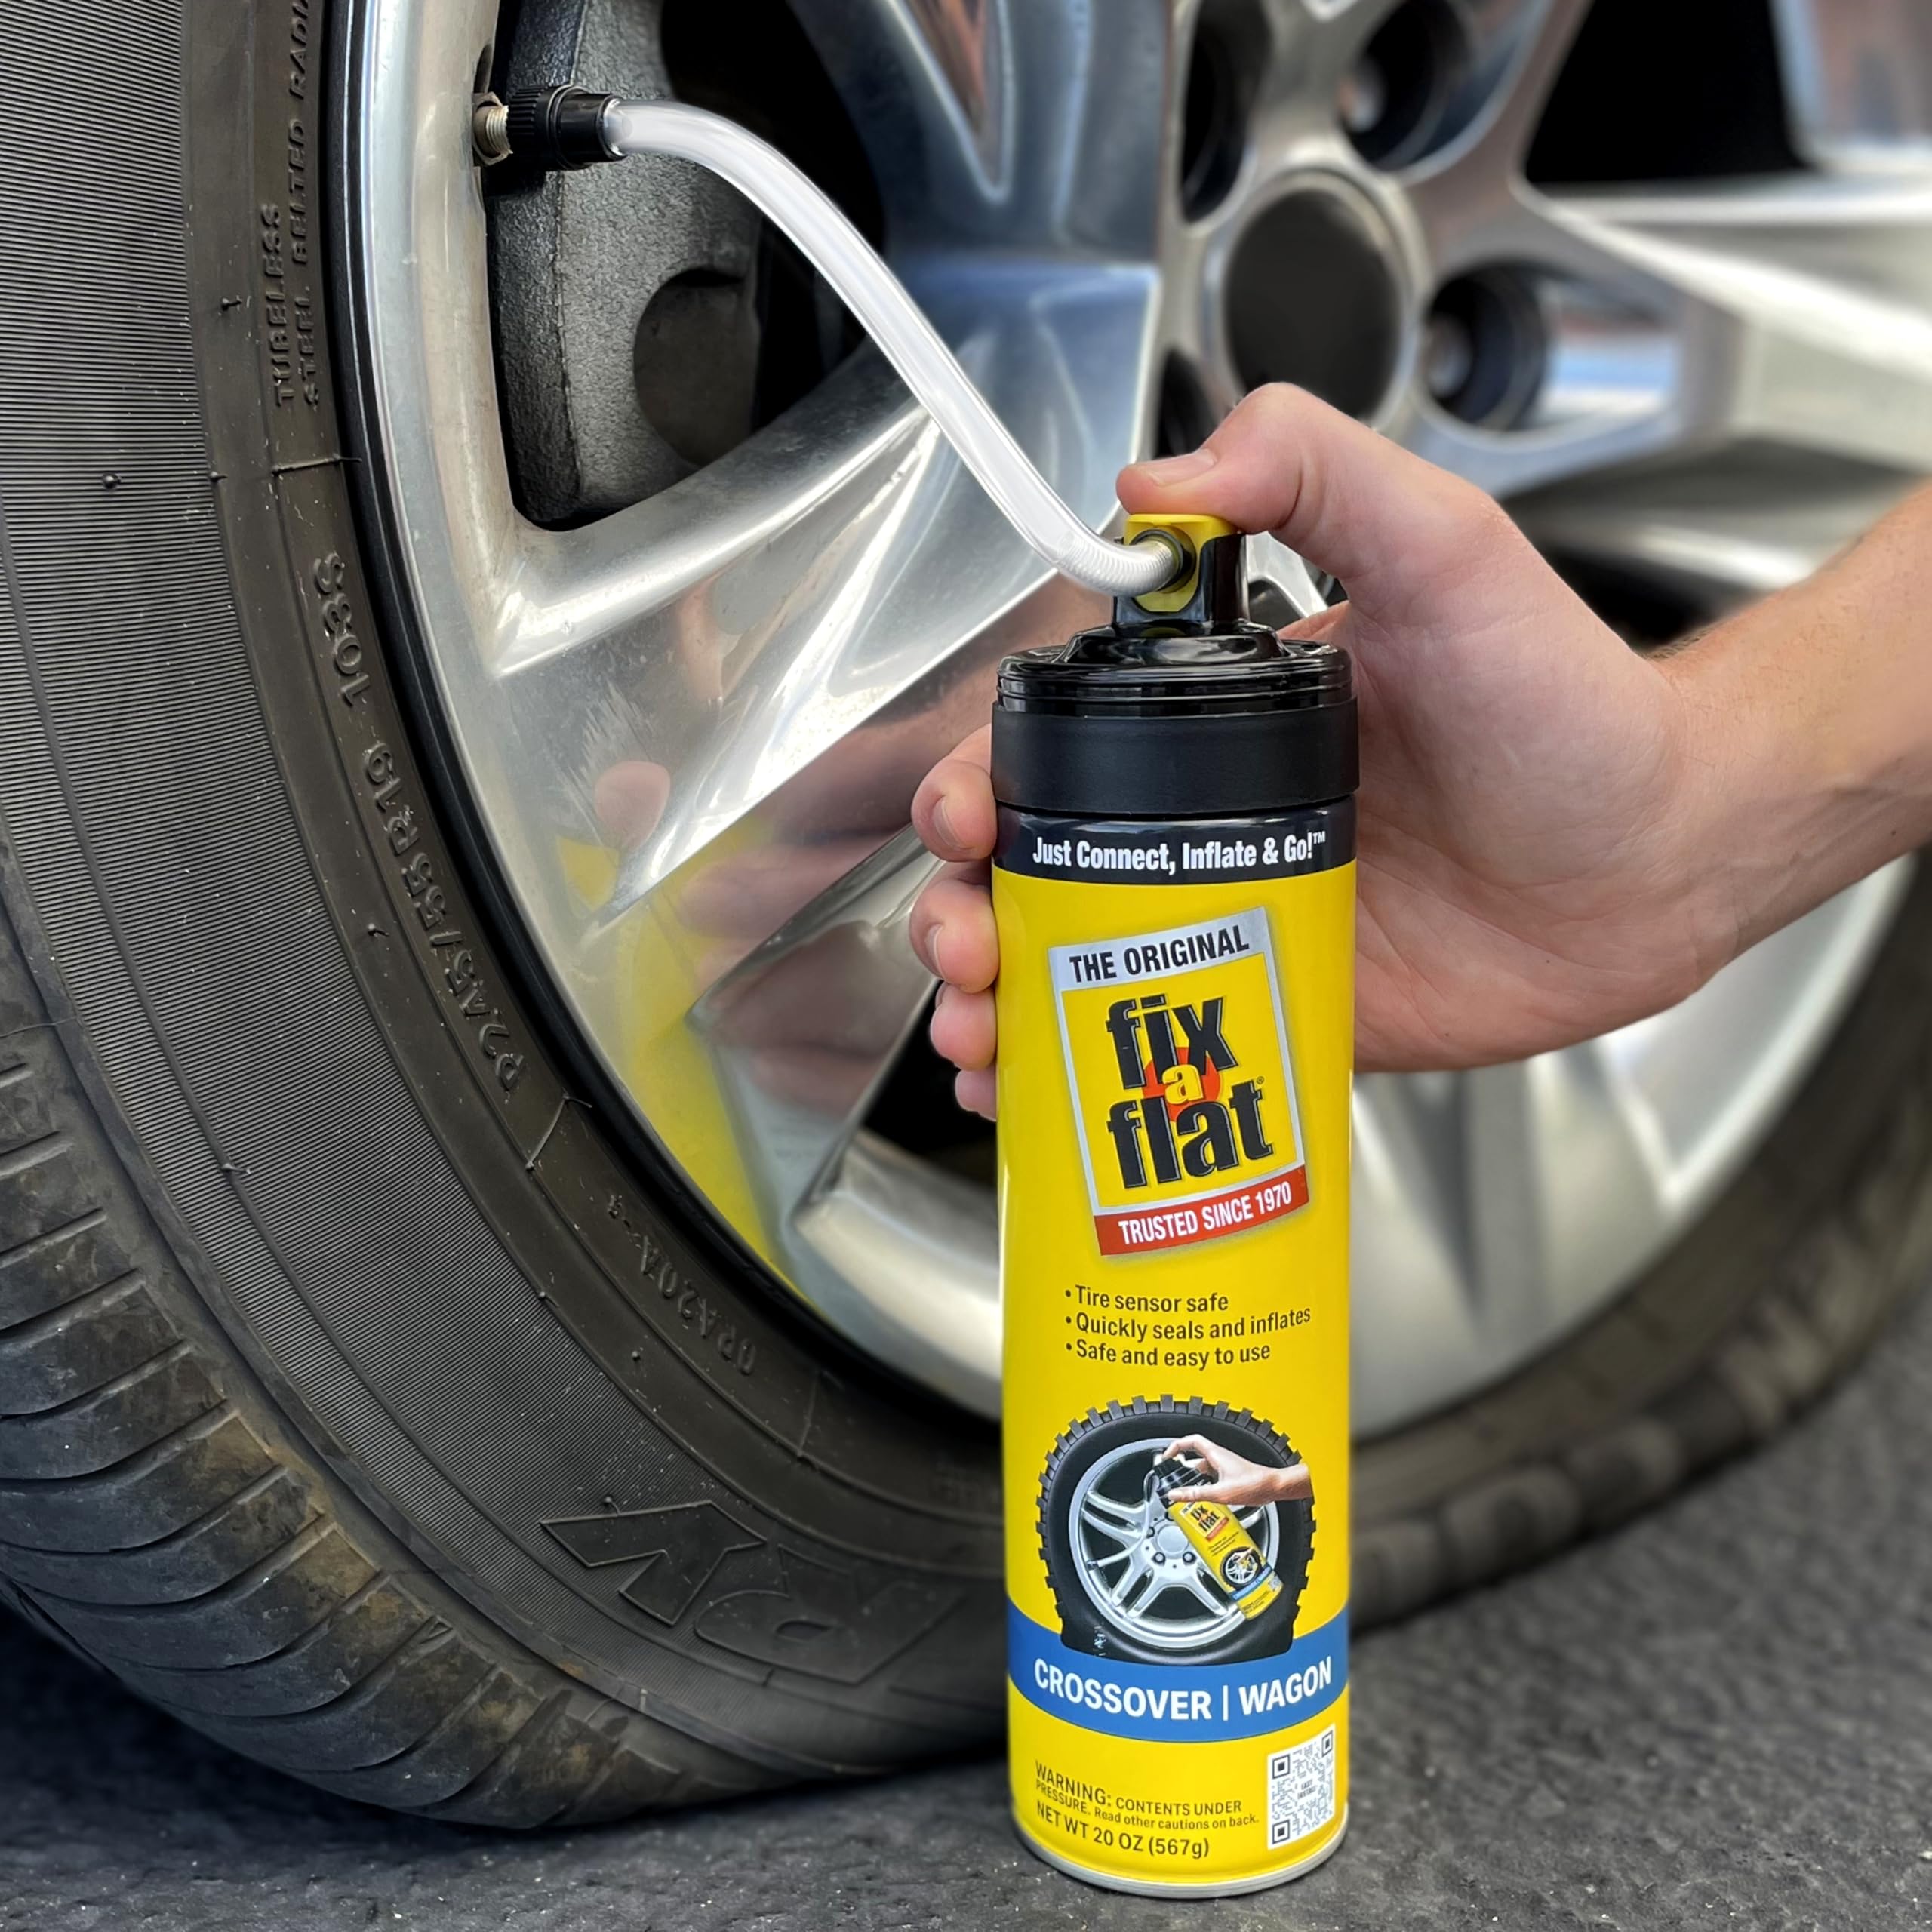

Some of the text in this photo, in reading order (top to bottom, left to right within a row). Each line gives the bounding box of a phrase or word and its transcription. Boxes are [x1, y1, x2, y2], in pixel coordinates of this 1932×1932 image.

[288, 0, 309, 100] RADI
[288, 118, 307, 264] BELTED
[261, 202, 294, 407] TUBELESS
[313, 552, 371, 708] 103S
[1032, 836, 1072, 866] Just
[1077, 841, 1176, 876] Connect,
[1182, 840, 1256, 870] Inflate
[1262, 837, 1279, 864] &
[1069, 924, 1250, 983] THE ORIGINAL
[1106, 993, 1239, 1091] fix
[1161, 1064, 1204, 1104] a
[1118, 1180, 1292, 1245] TRUSTED SINCE 1970
[1075, 1284, 1229, 1312] Tire sensor safe
[1076, 1307, 1311, 1343] Quickly seals and inflates
[1076, 1338, 1271, 1371] Safe and easy to use
[1034, 1657, 1212, 1721] CROSSOVER
[1238, 1656, 1332, 1715] WAGON
[1035, 1759, 1241, 1817] WARNING: CONTENTS UNDER
[1035, 1778, 1260, 1830] PRESSURE. Read other cautions on back.
[1037, 1800, 1208, 1860] NET WT 20 OZ (567g)
